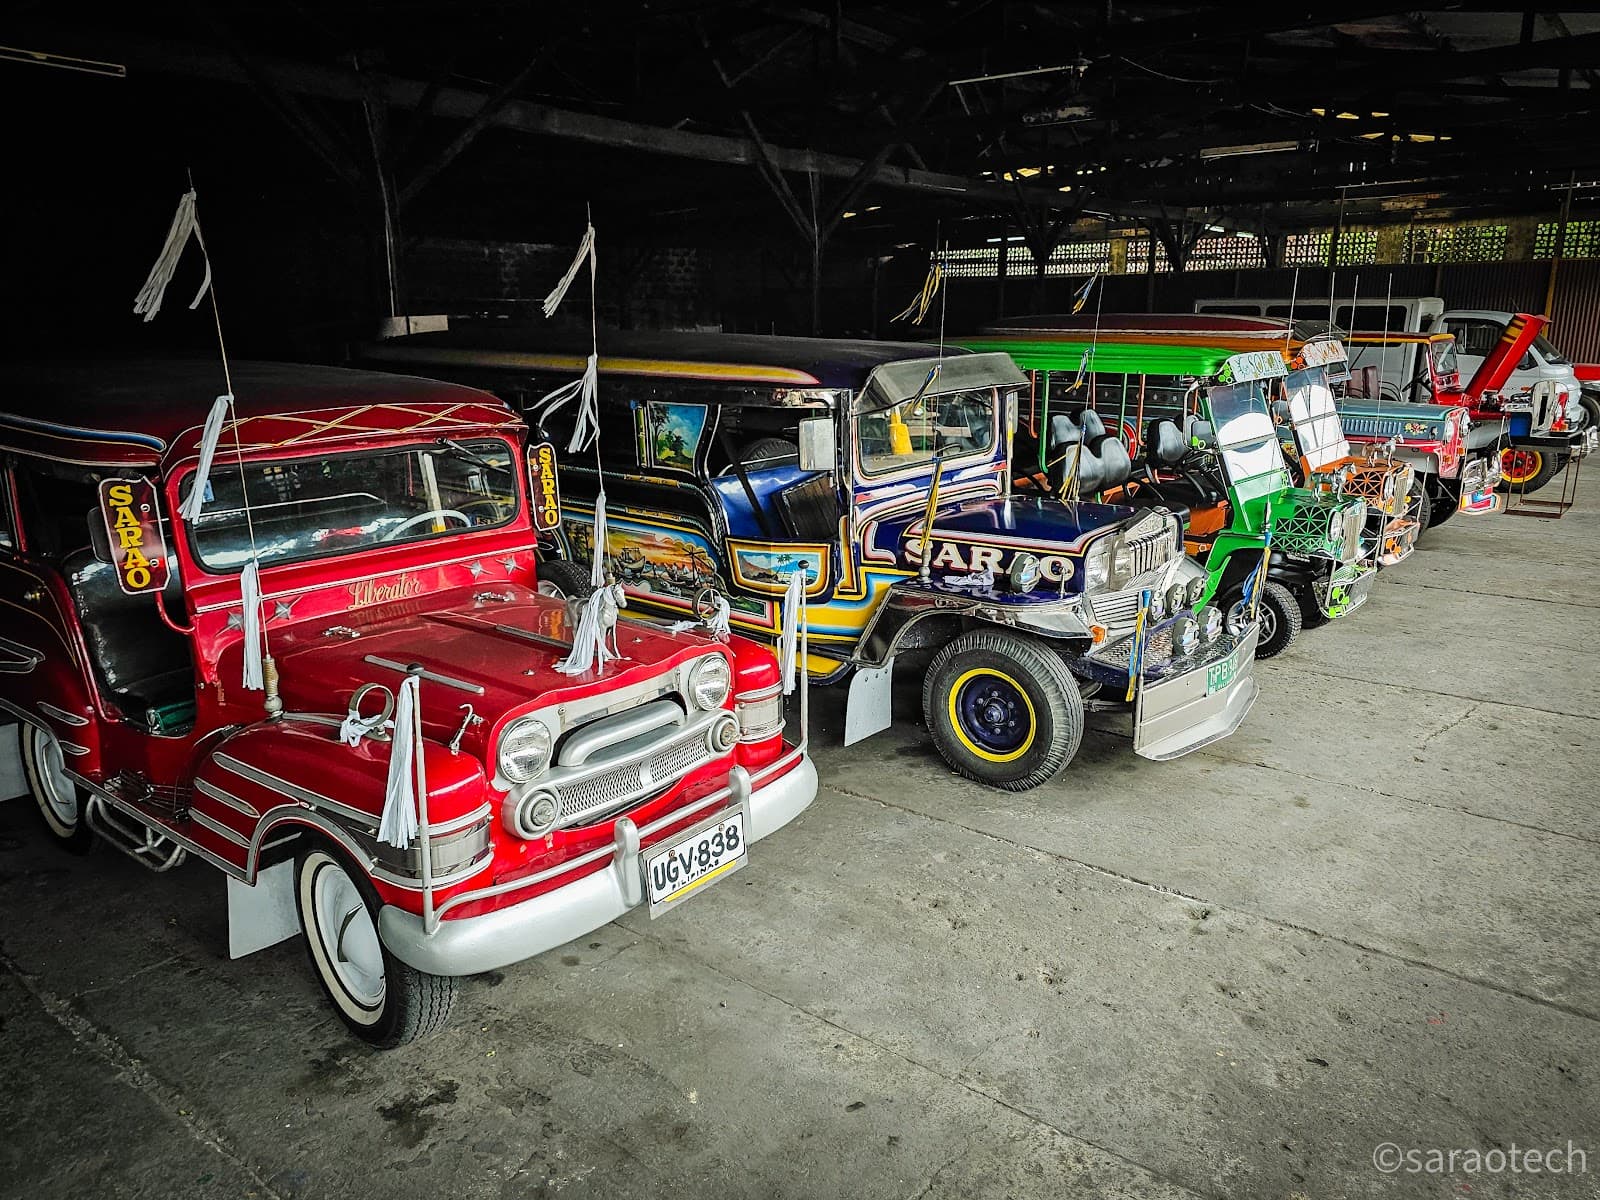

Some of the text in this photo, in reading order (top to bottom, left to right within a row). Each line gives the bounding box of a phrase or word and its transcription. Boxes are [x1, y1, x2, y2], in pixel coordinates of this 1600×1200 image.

[538, 446, 559, 526] SARAO
[108, 484, 151, 589] SARAO
[348, 573, 424, 609] Liberator
